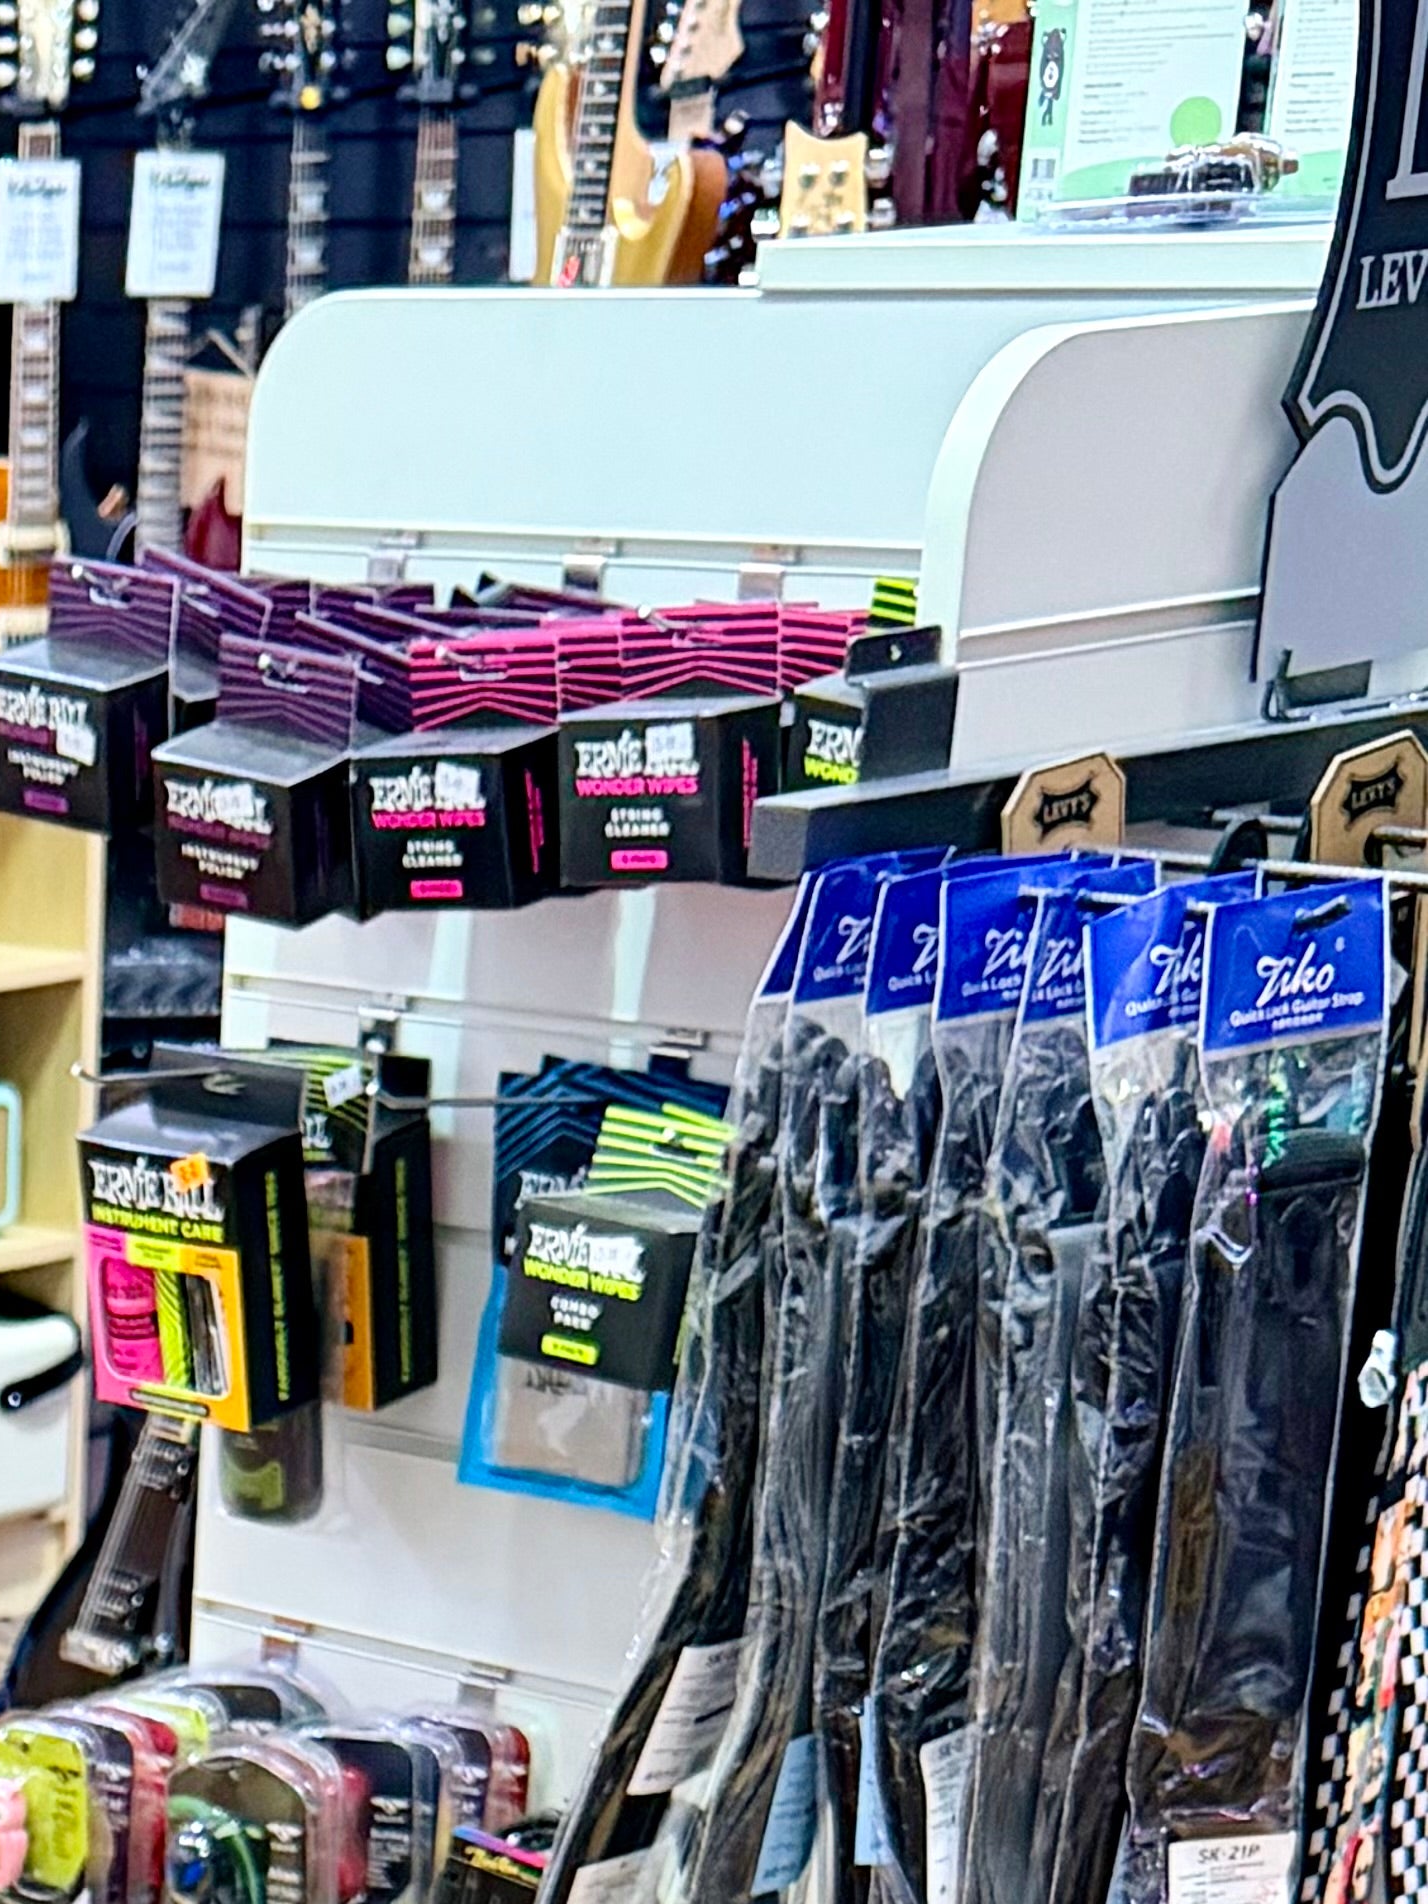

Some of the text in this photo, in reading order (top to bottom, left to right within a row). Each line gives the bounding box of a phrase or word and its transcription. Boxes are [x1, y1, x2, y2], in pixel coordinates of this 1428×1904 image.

[806, 718, 864, 769] ERN
[804, 755, 860, 786] WOND
[91, 1203, 225, 1244] INSTRUMENT CARE
